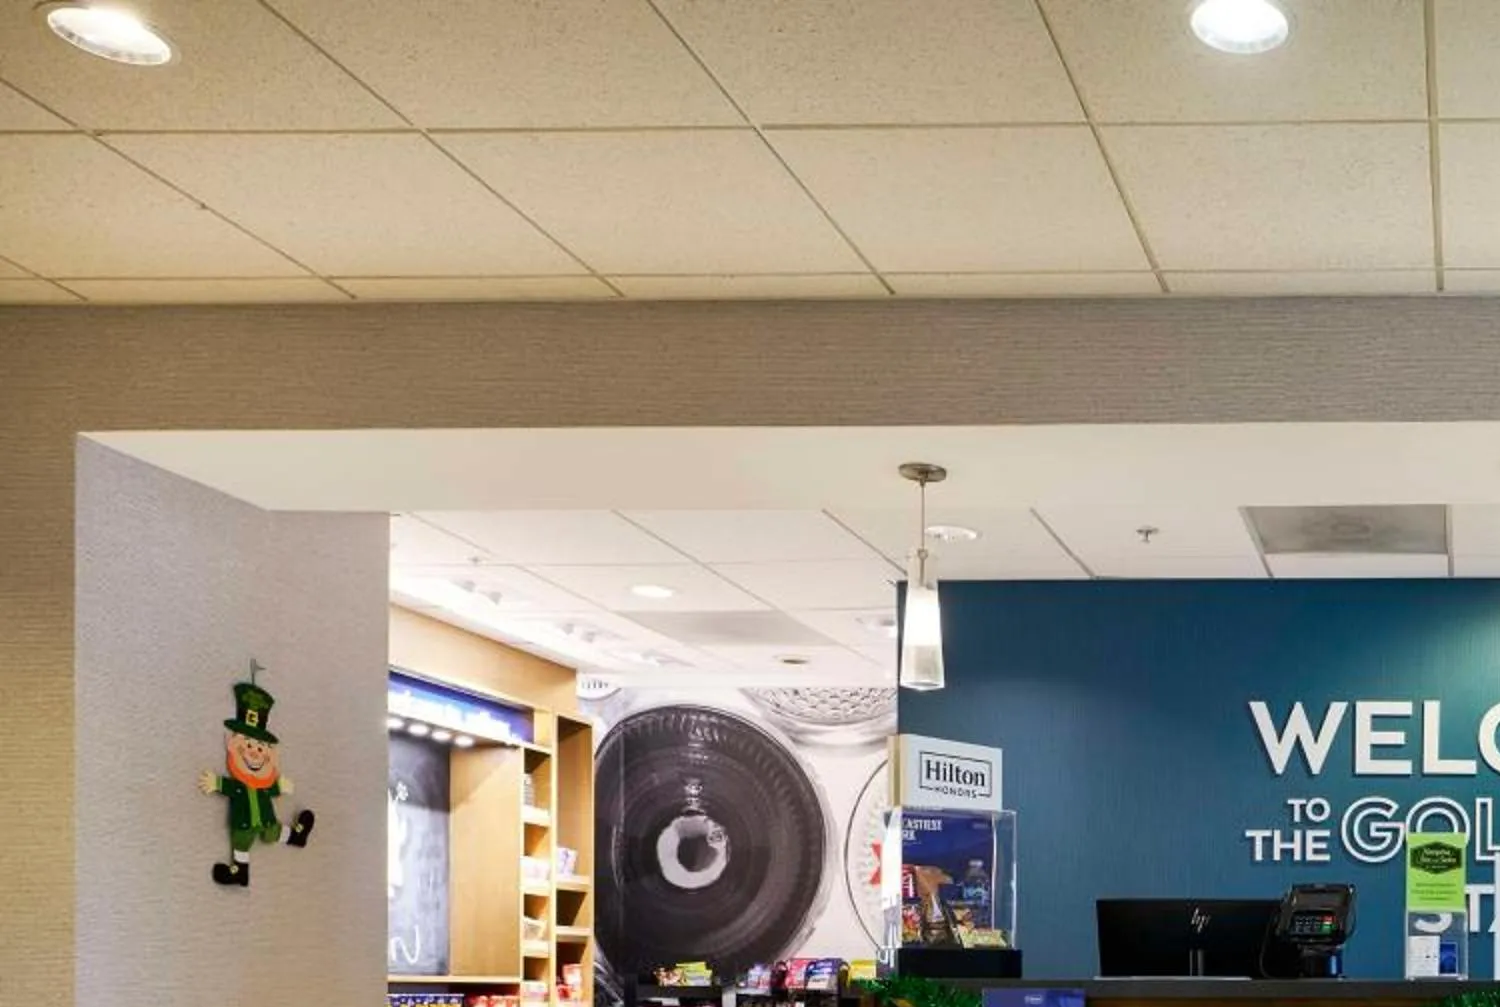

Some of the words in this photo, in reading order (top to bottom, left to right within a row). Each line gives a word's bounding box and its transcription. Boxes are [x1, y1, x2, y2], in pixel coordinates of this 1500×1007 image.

[926, 759, 985, 787] Hilton
[934, 786, 977, 799] HONORS
[1287, 798, 1331, 823] TO
[1246, 829, 1331, 862] THE
